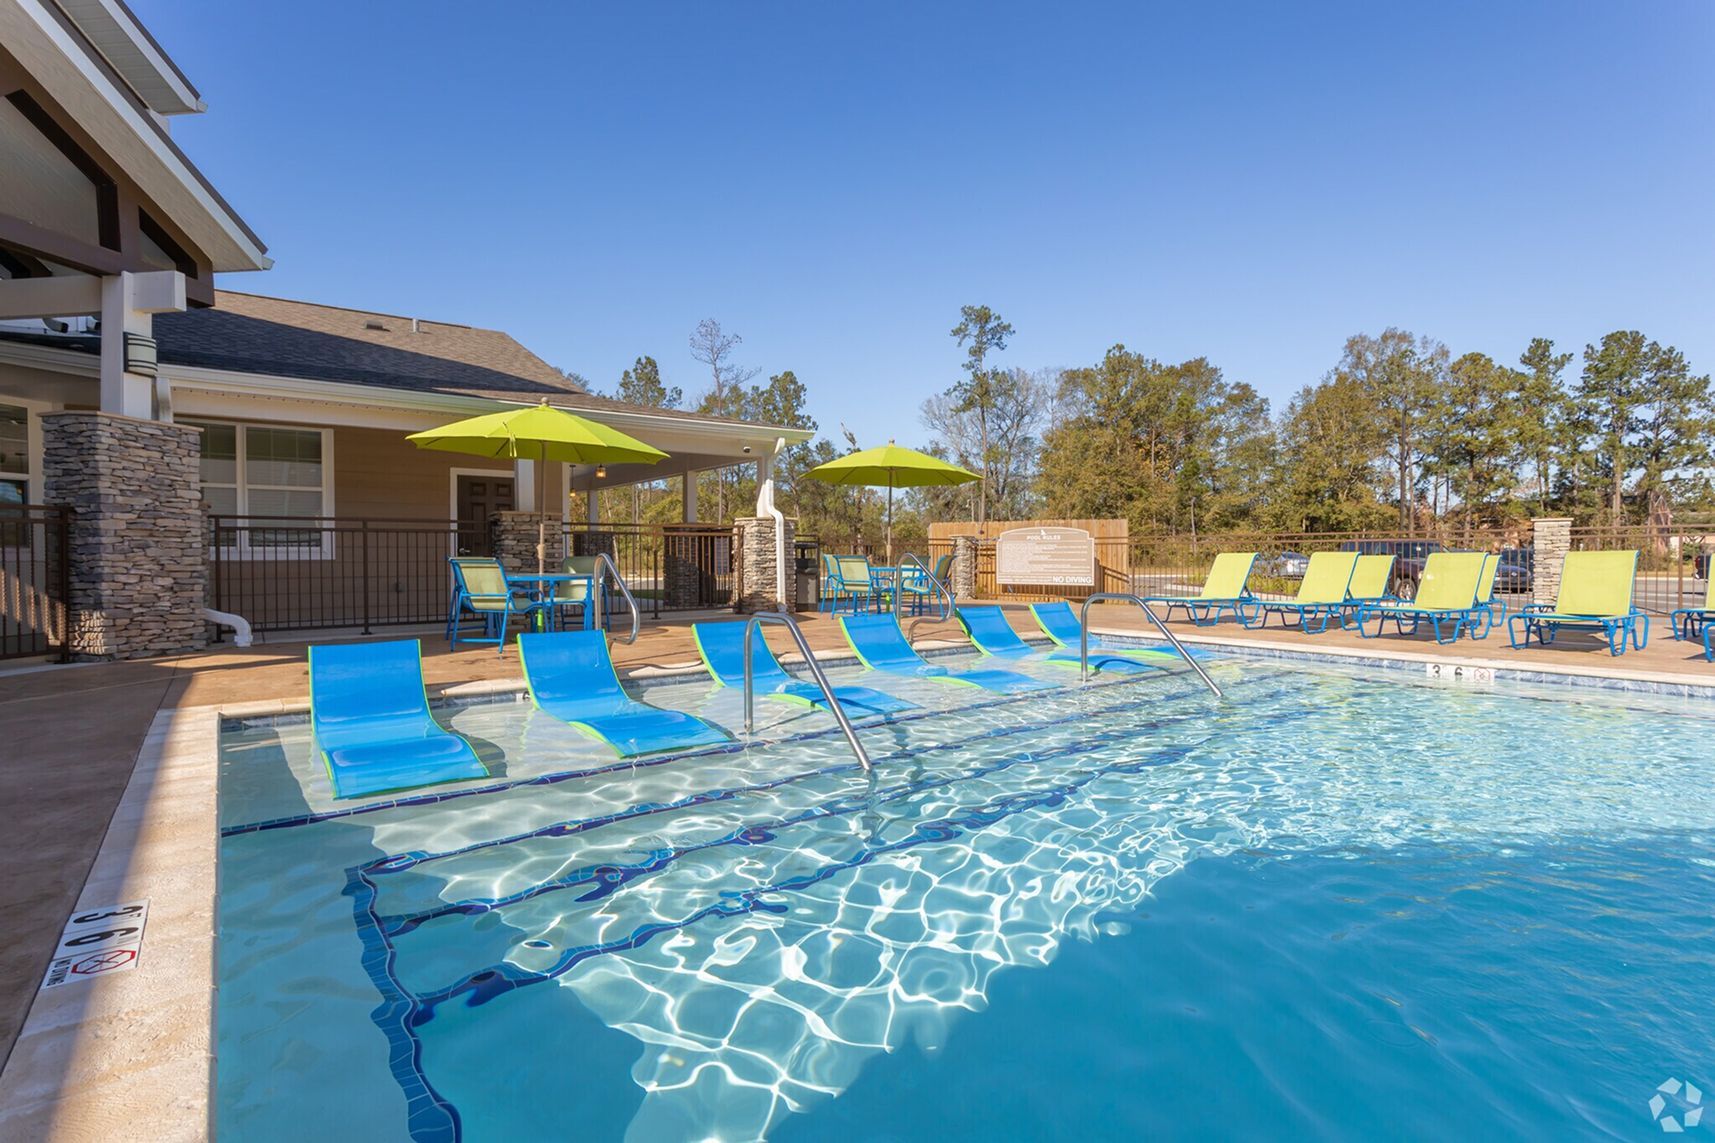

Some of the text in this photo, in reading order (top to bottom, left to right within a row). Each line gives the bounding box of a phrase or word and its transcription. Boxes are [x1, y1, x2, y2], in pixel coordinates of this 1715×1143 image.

[1065, 576, 1092, 584] DIVING
[73, 906, 143, 923] 3
[64, 927, 139, 947] 6
